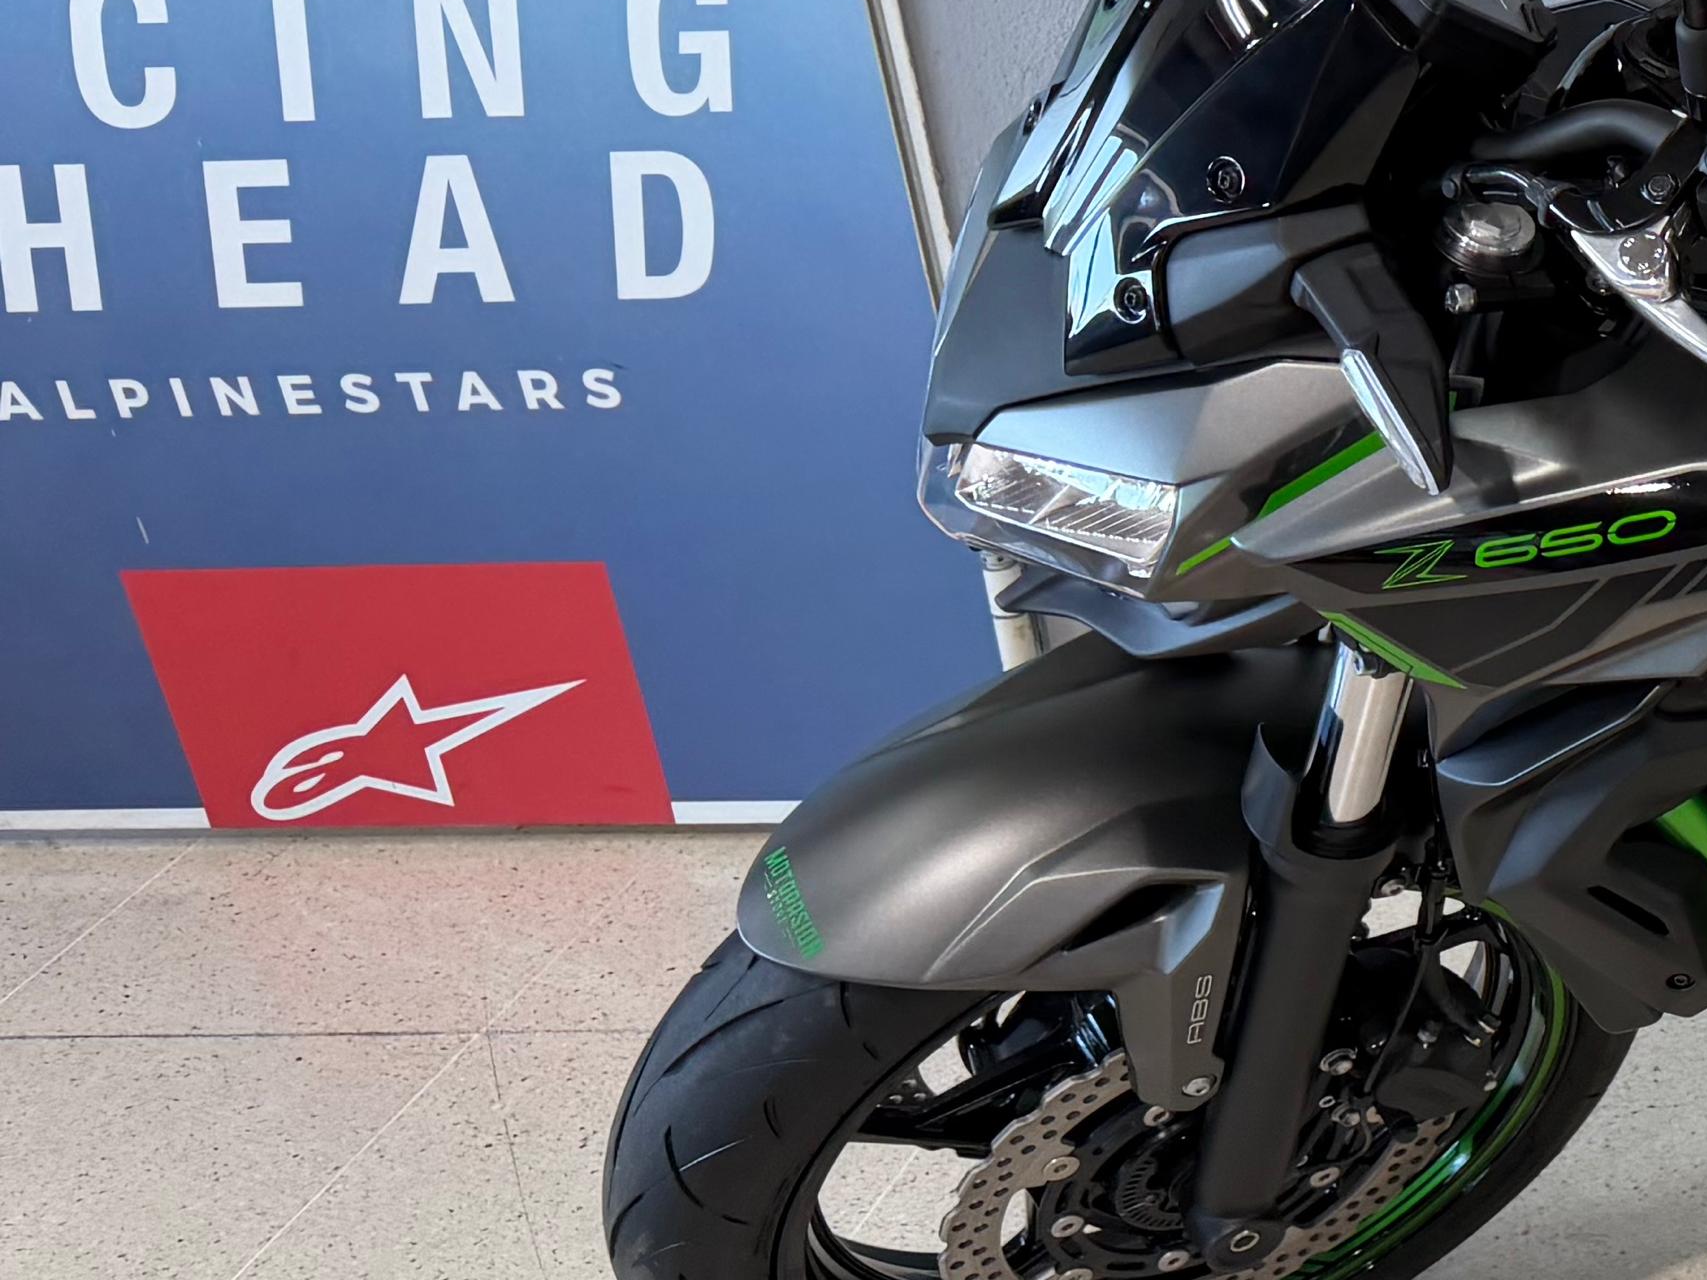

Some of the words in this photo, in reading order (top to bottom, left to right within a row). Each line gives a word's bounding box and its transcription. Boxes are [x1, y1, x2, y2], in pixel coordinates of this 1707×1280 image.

[0, 150, 715, 312] HEAD
[0, 368, 622, 420] ALPINESTARS
[1187, 974, 1212, 1045] ABS
